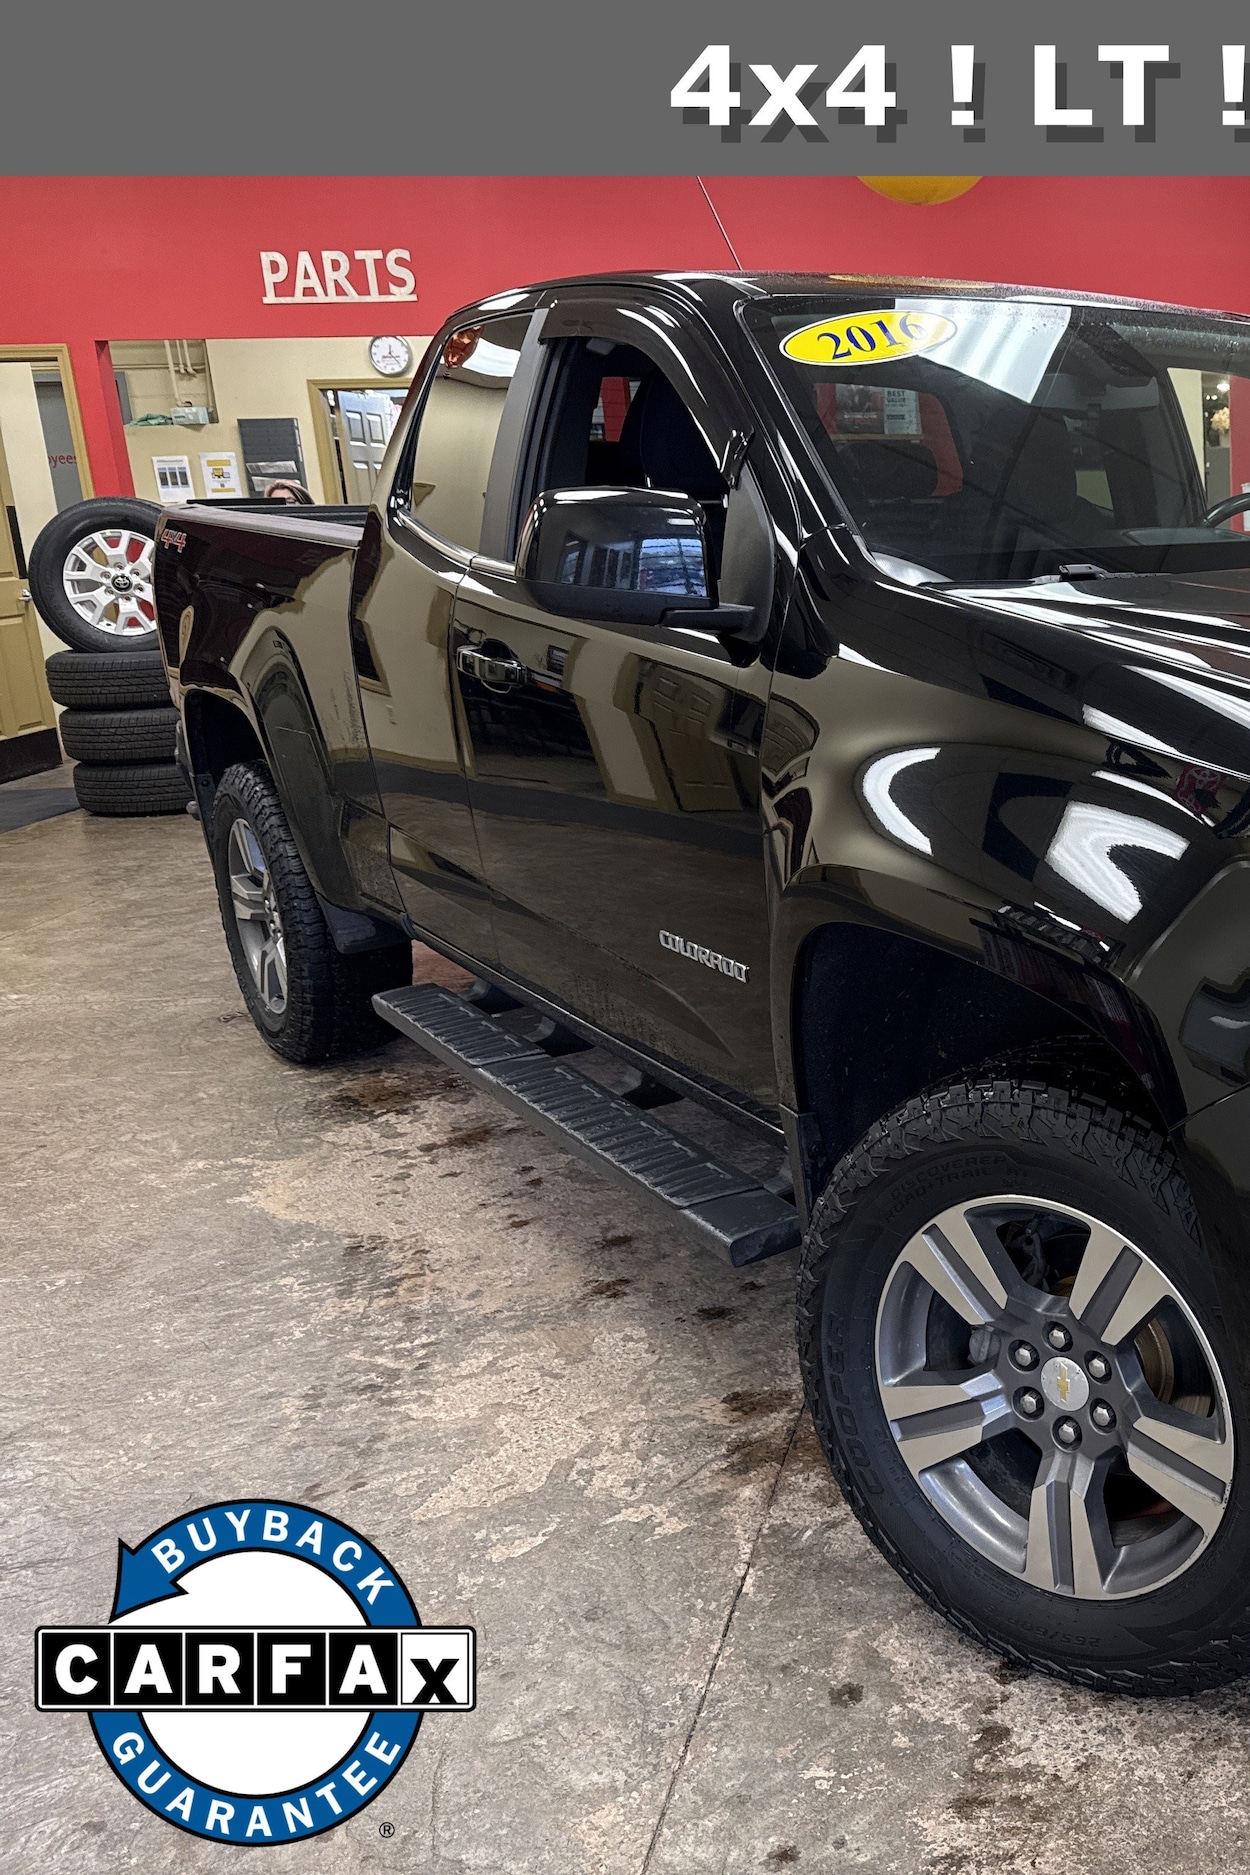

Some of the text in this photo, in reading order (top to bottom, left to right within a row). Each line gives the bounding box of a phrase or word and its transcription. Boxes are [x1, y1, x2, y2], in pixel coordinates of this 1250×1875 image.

[259, 248, 417, 300] PARTS
[817, 313, 928, 360] 2016
[659, 929, 749, 984] COLORADO
[826, 1312, 885, 1496] COOPER
